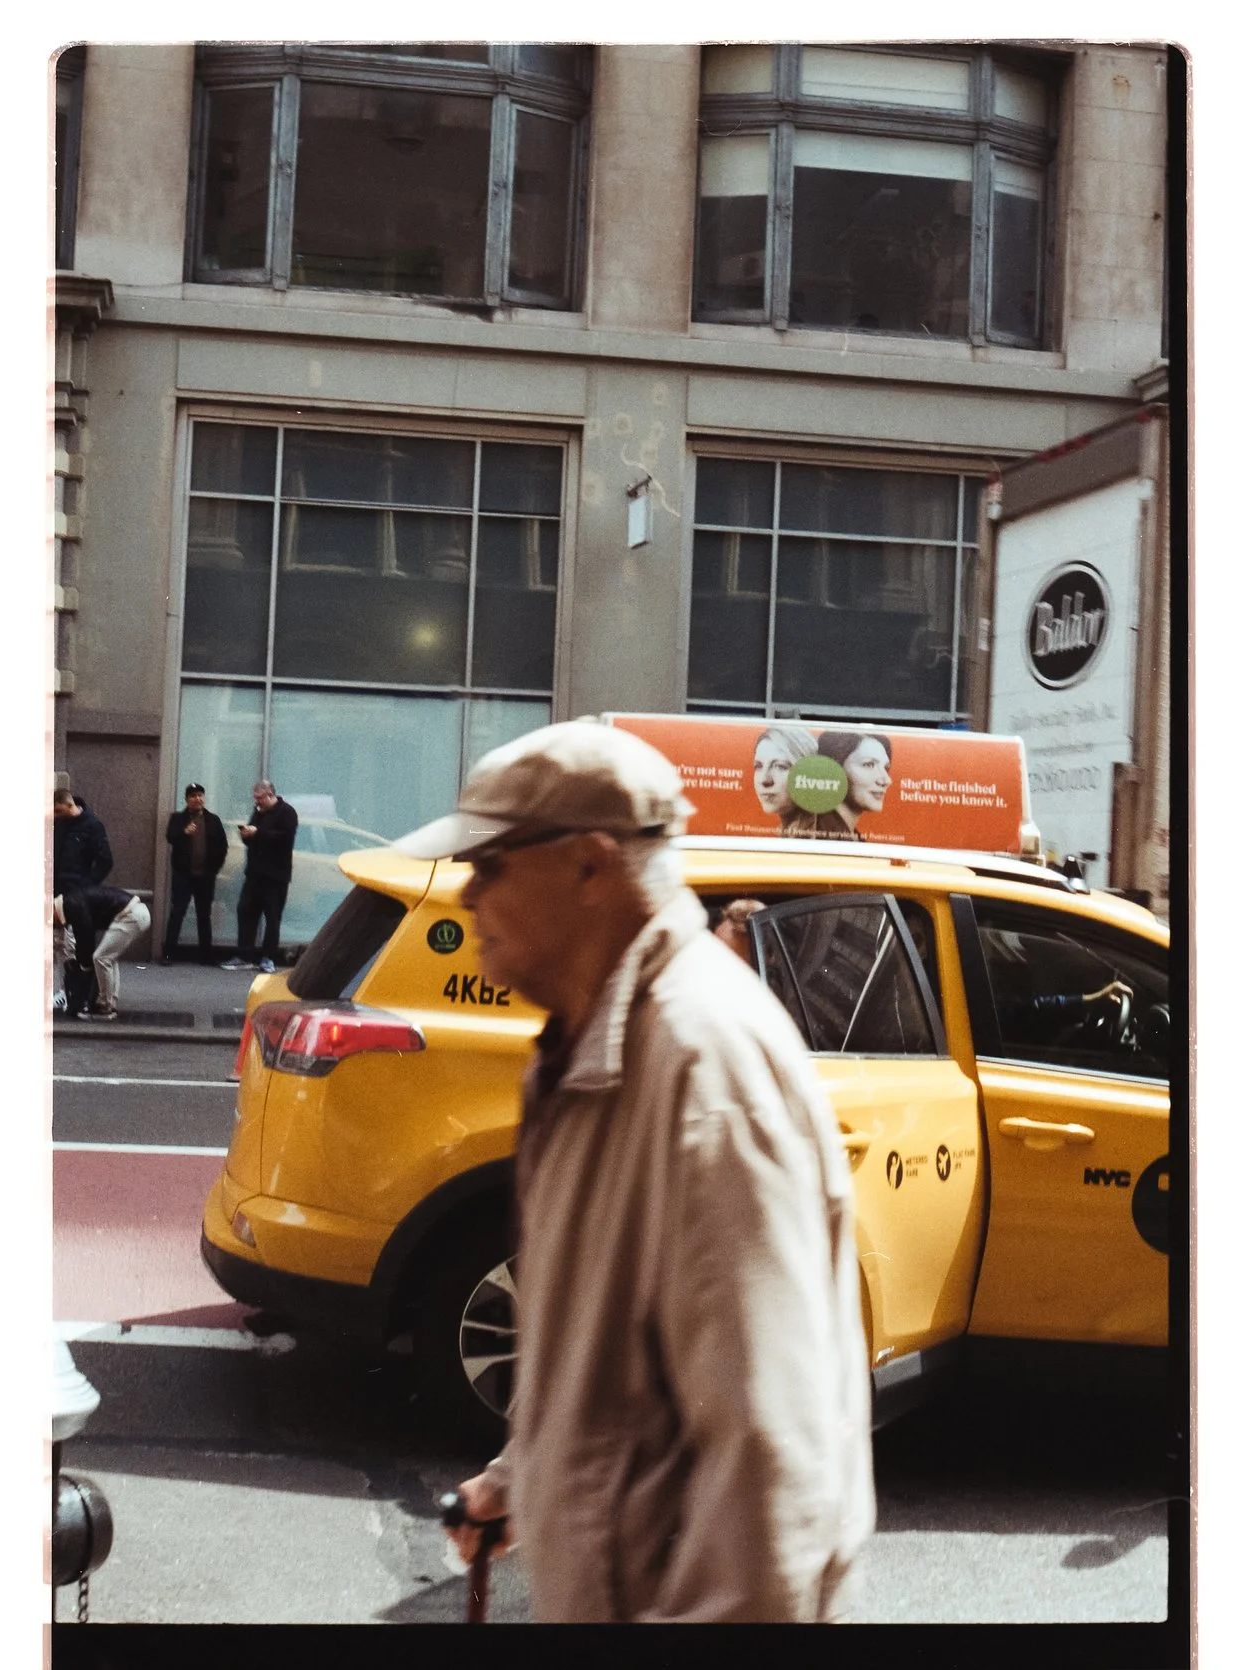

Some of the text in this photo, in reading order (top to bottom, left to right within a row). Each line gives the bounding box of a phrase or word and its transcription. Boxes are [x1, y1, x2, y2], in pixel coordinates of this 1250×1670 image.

[696, 766, 716, 777] not
[717, 768, 743, 779] sure
[699, 778, 711, 789] to
[712, 779, 743, 791] start.
[795, 775, 840, 791] fiverr
[900, 778, 997, 795] She'll be finished
[900, 790, 1008, 808] before you know it.
[1083, 1167, 1131, 1188] NYC
